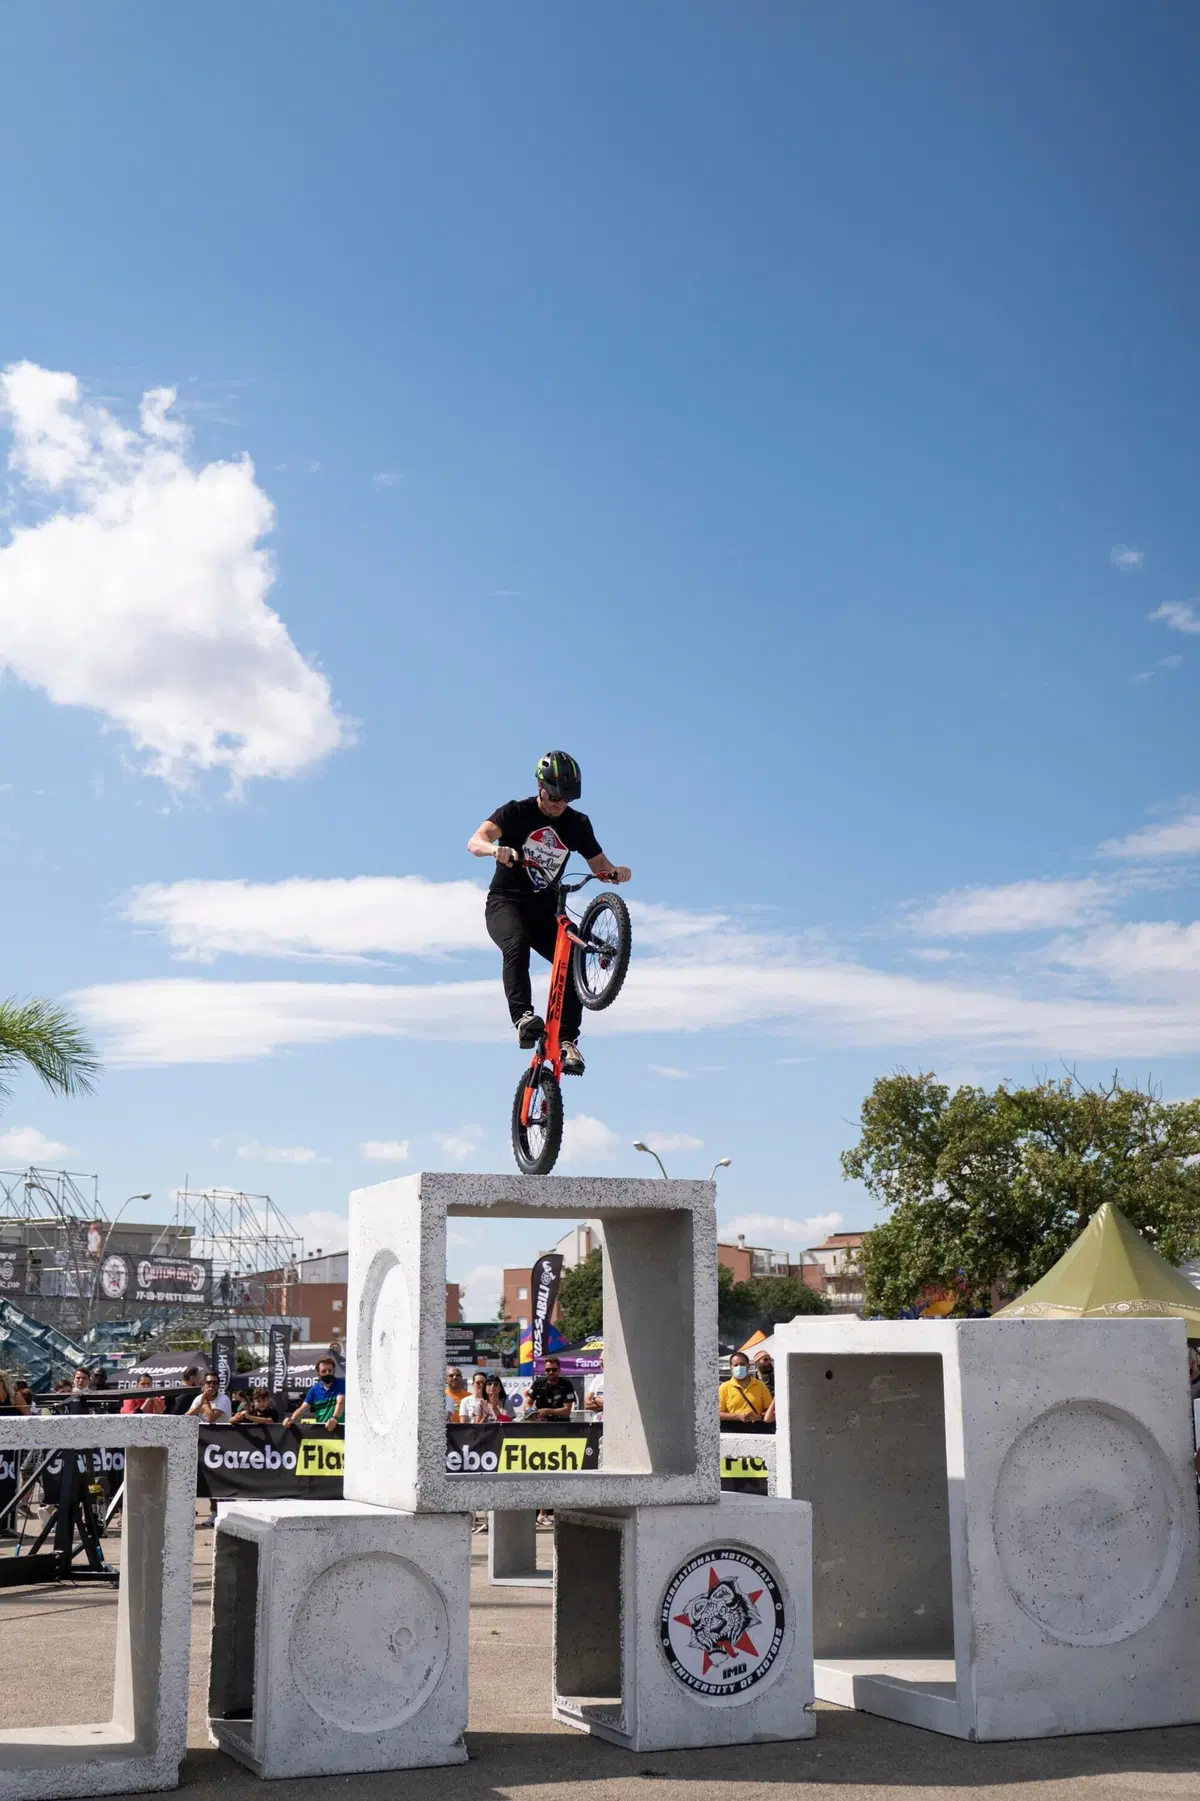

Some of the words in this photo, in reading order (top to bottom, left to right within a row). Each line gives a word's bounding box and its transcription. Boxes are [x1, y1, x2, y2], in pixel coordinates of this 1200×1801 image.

[555, 975, 566, 1019] COMAS
[1103, 1300, 1169, 1315] FORST
[128, 1366, 188, 1377] TRIUMPH
[273, 1343, 286, 1394] TRIUMPH
[248, 1377, 268, 1388] FOR
[204, 1443, 297, 1470] Gazebo
[303, 1445, 345, 1470] Fla
[504, 1445, 579, 1471] Flash
[662, 1554, 717, 1622] INTERNATIONAL
[720, 1551, 754, 1567] MOTOR
[755, 1564, 775, 1590] DAYS
[671, 1660, 736, 1693] UNIVERSITY
[740, 1676, 754, 1690] OF
[756, 1627, 782, 1677] MOTORS
[722, 1663, 747, 1680] IMD
